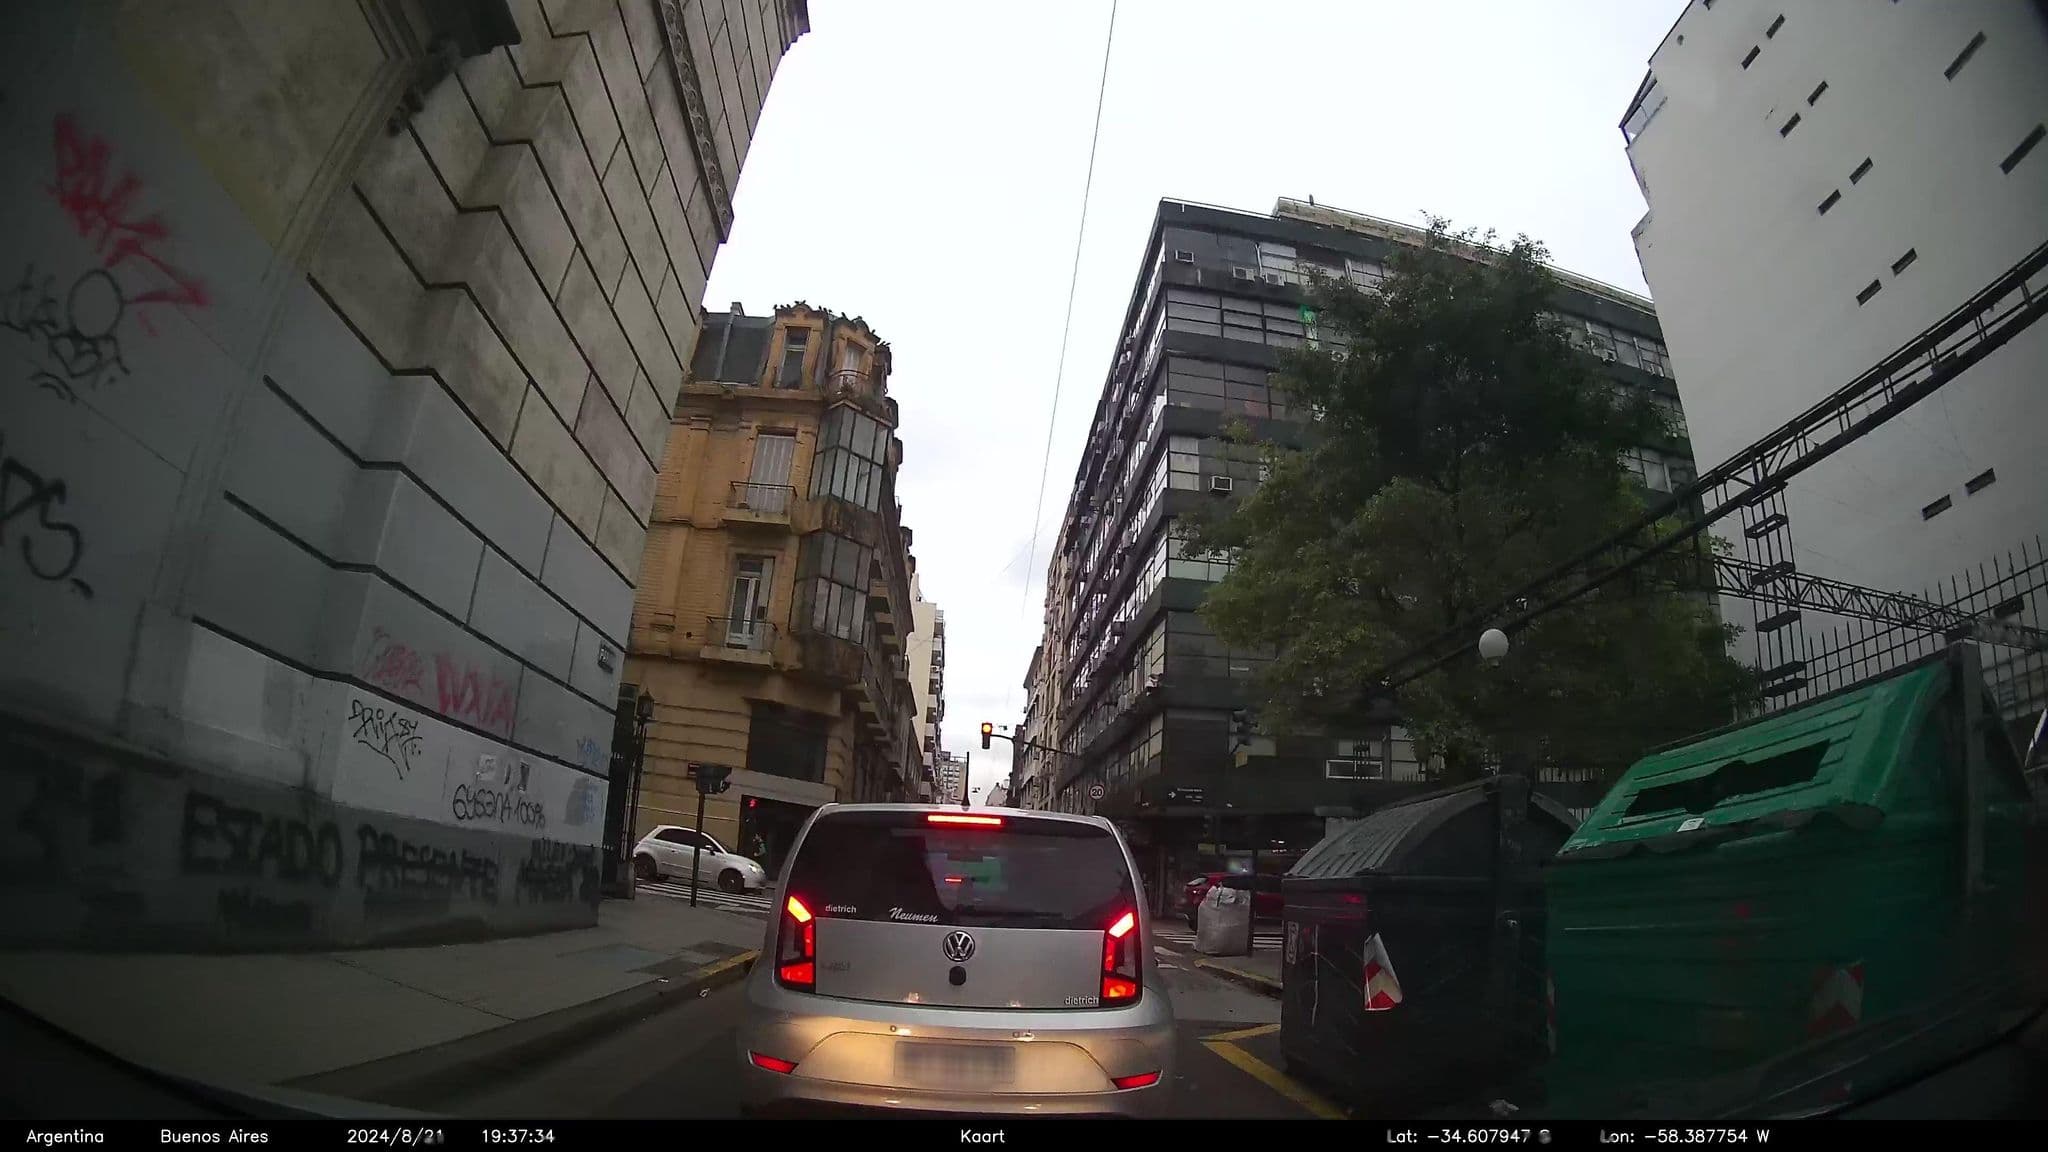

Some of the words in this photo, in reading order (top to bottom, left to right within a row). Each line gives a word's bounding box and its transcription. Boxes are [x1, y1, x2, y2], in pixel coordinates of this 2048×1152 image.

[1091, 788, 1103, 797] 20
[824, 904, 857, 914] dietrich
[888, 905, 939, 923] Neumen
[1065, 995, 1099, 1005] dietrich
